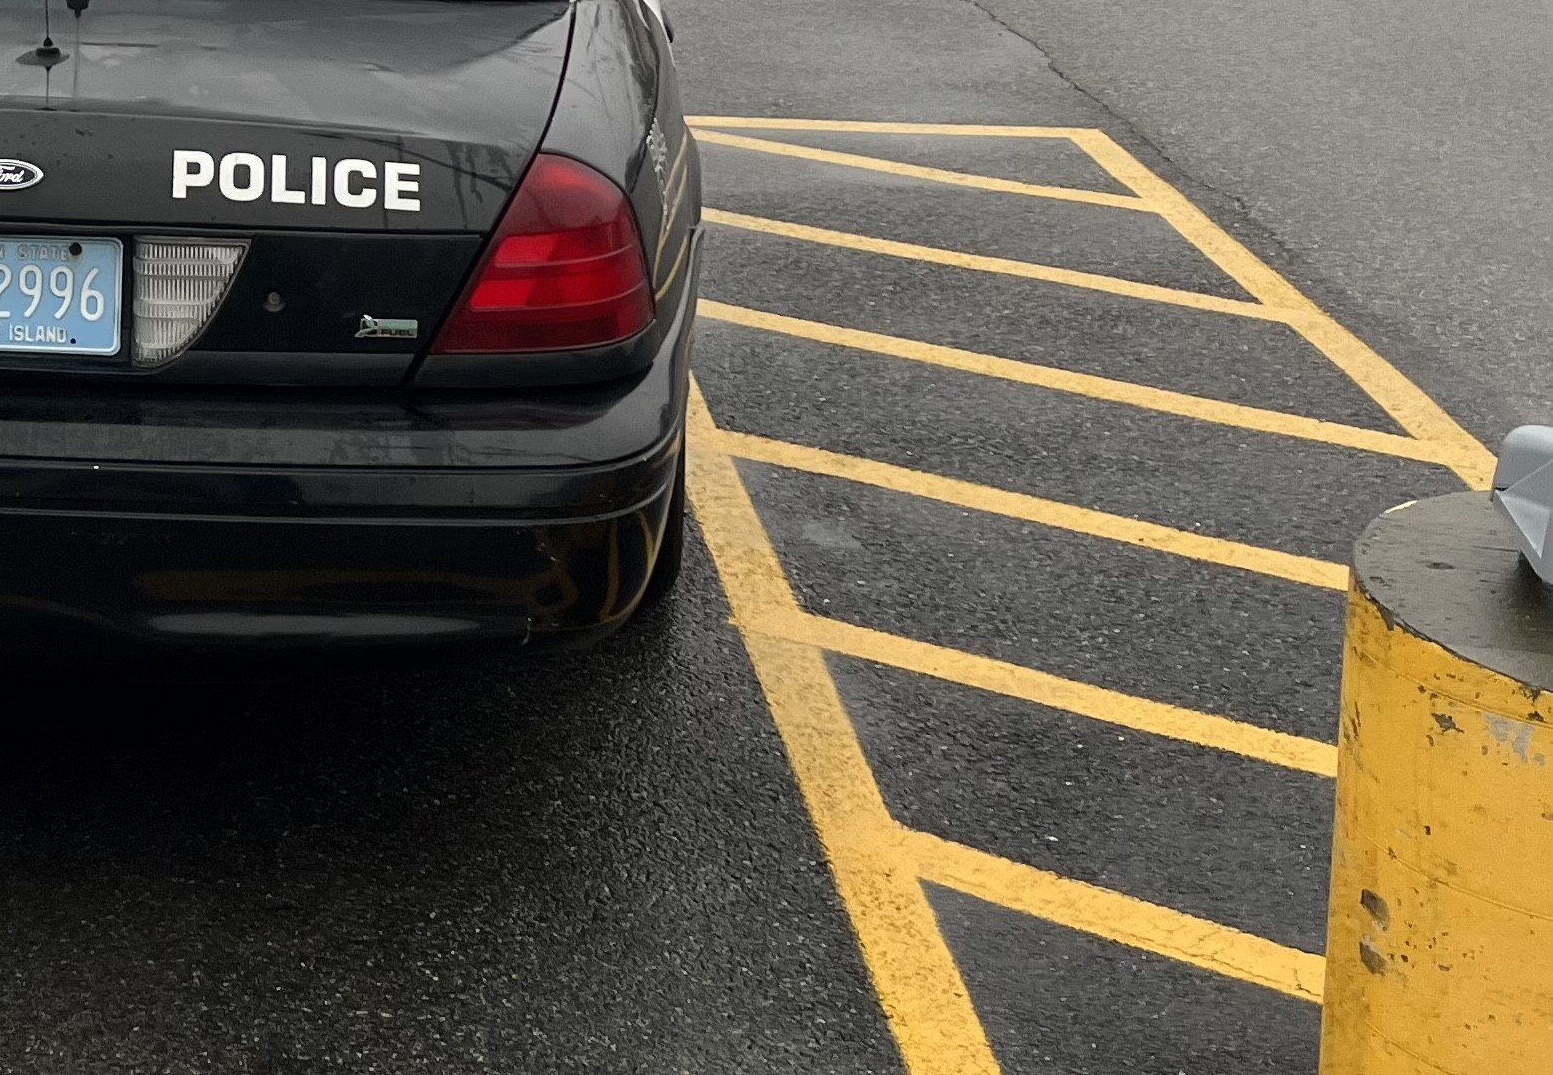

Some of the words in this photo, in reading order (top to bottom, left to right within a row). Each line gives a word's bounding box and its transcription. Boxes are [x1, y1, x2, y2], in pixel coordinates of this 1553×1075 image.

[172, 149, 421, 212] POLICE
[18, 243, 69, 261] STATE
[8, 324, 67, 343] ISLAND
